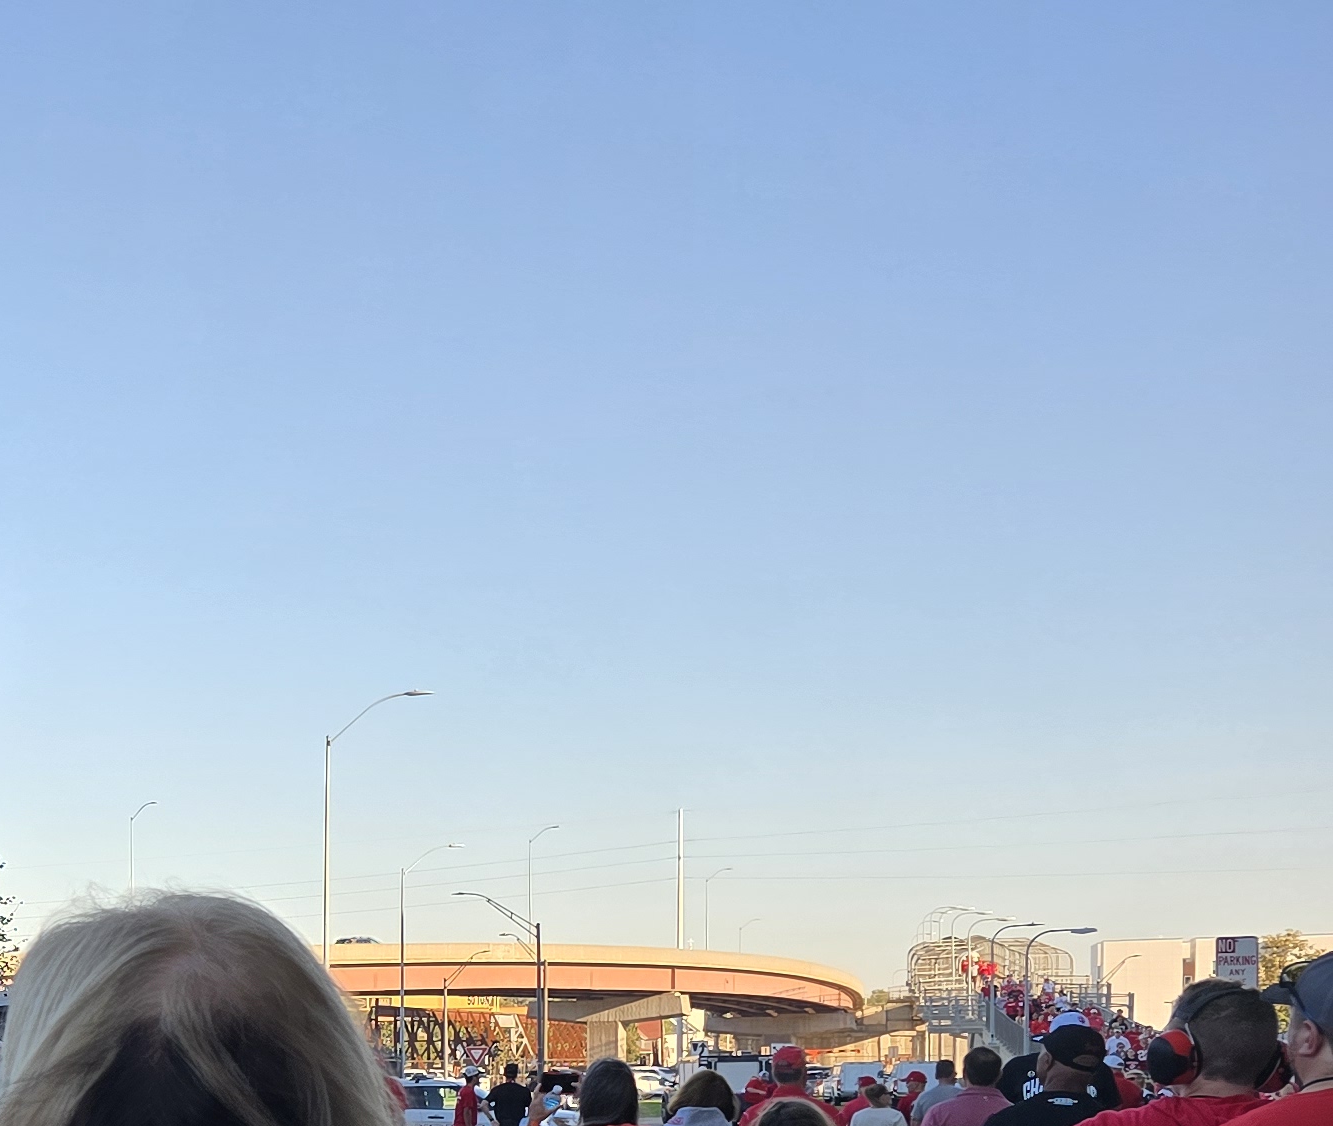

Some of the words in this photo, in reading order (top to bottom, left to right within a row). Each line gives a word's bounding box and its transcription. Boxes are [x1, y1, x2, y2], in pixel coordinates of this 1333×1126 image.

[1218, 939, 1234, 953] NO
[1217, 955, 1257, 966] PARKING
[1229, 968, 1246, 976] ANY
